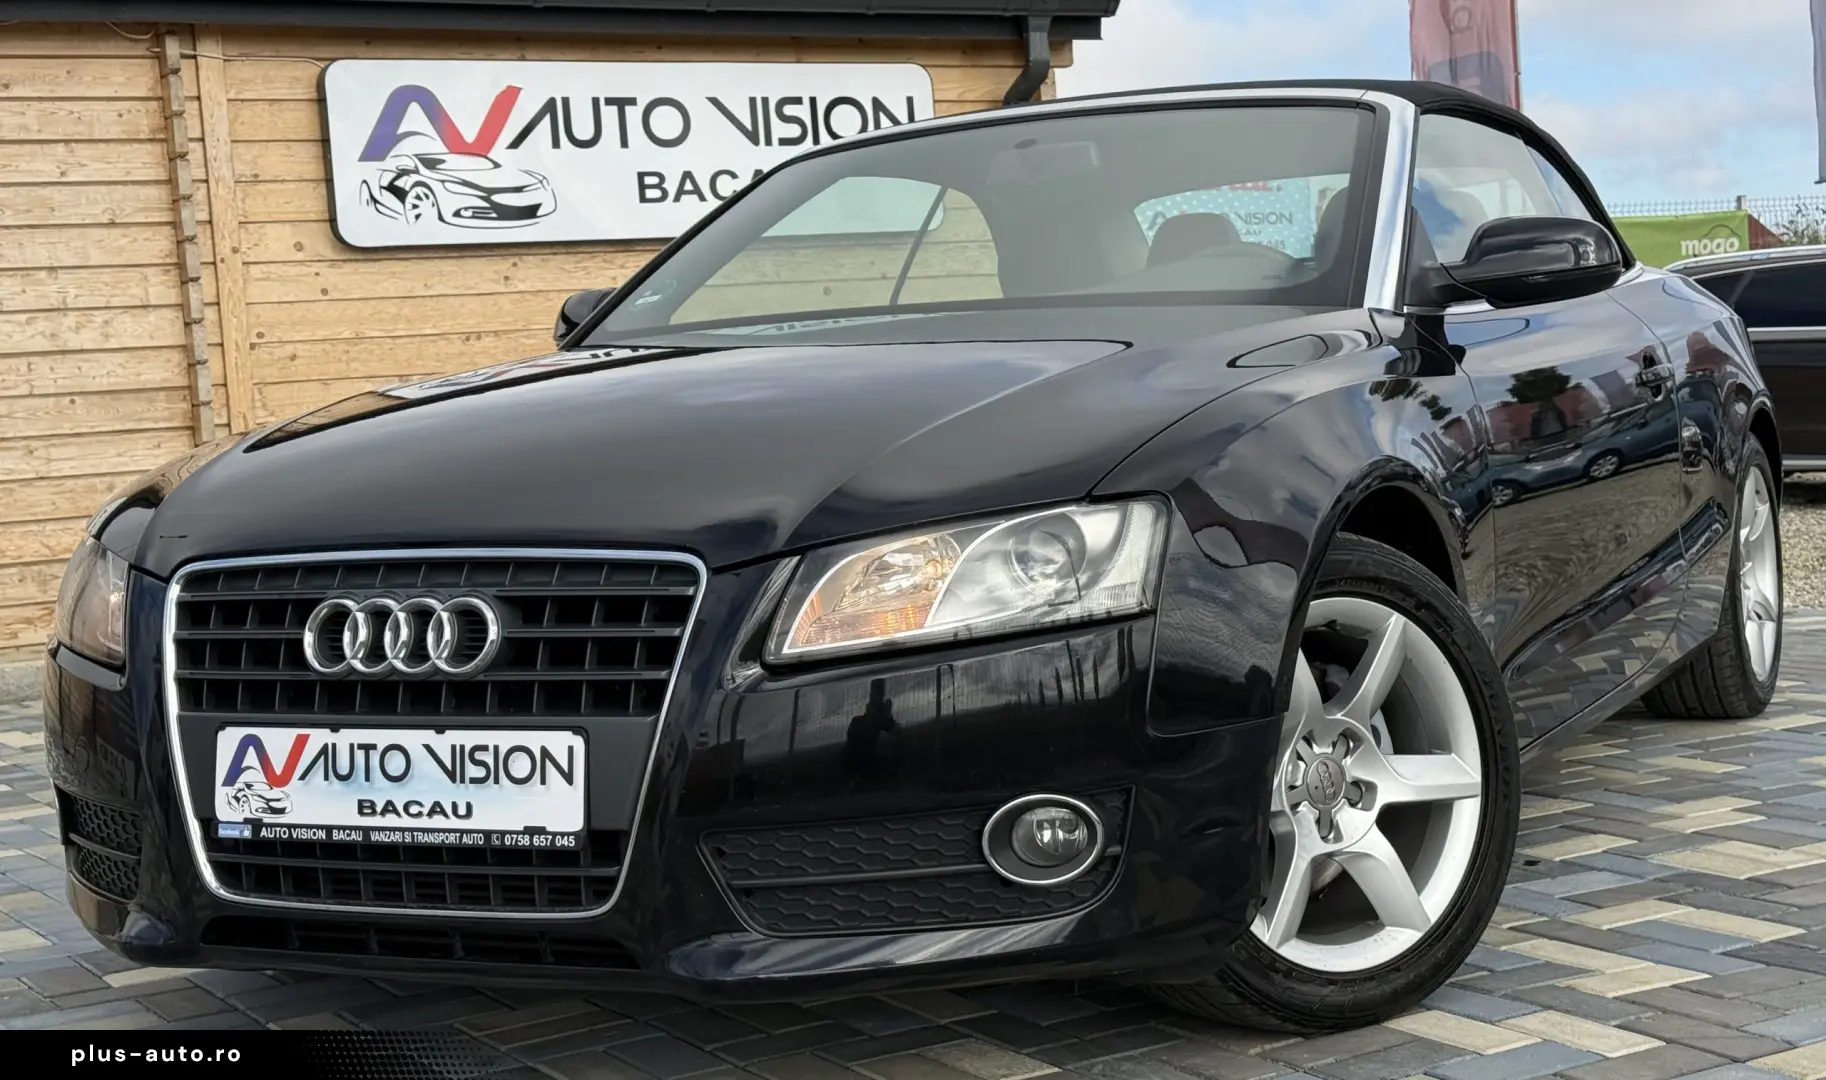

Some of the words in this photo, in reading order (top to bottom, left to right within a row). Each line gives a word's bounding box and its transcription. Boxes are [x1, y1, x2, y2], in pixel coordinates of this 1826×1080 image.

[505, 96, 691, 150] AUTO
[705, 96, 915, 147] VISION
[637, 169, 766, 204] BAC
[1234, 212, 1293, 225] VISION
[1680, 237, 1740, 257] mogo
[297, 742, 412, 783] AUTO
[421, 743, 574, 786] VISION
[357, 799, 473, 820] BACAU
[260, 827, 289, 839] AUTO
[291, 828, 326, 840] VISION
[332, 829, 363, 841] BACAU
[370, 830, 403, 843] VANZARI
[404, 832, 412, 843] SI
[413, 832, 461, 844] TRANSPORT
[462, 833, 485, 845] AUTO
[504, 834, 530, 846] 0758
[532, 835, 552, 847] 657
[555, 835, 576, 847] 045
